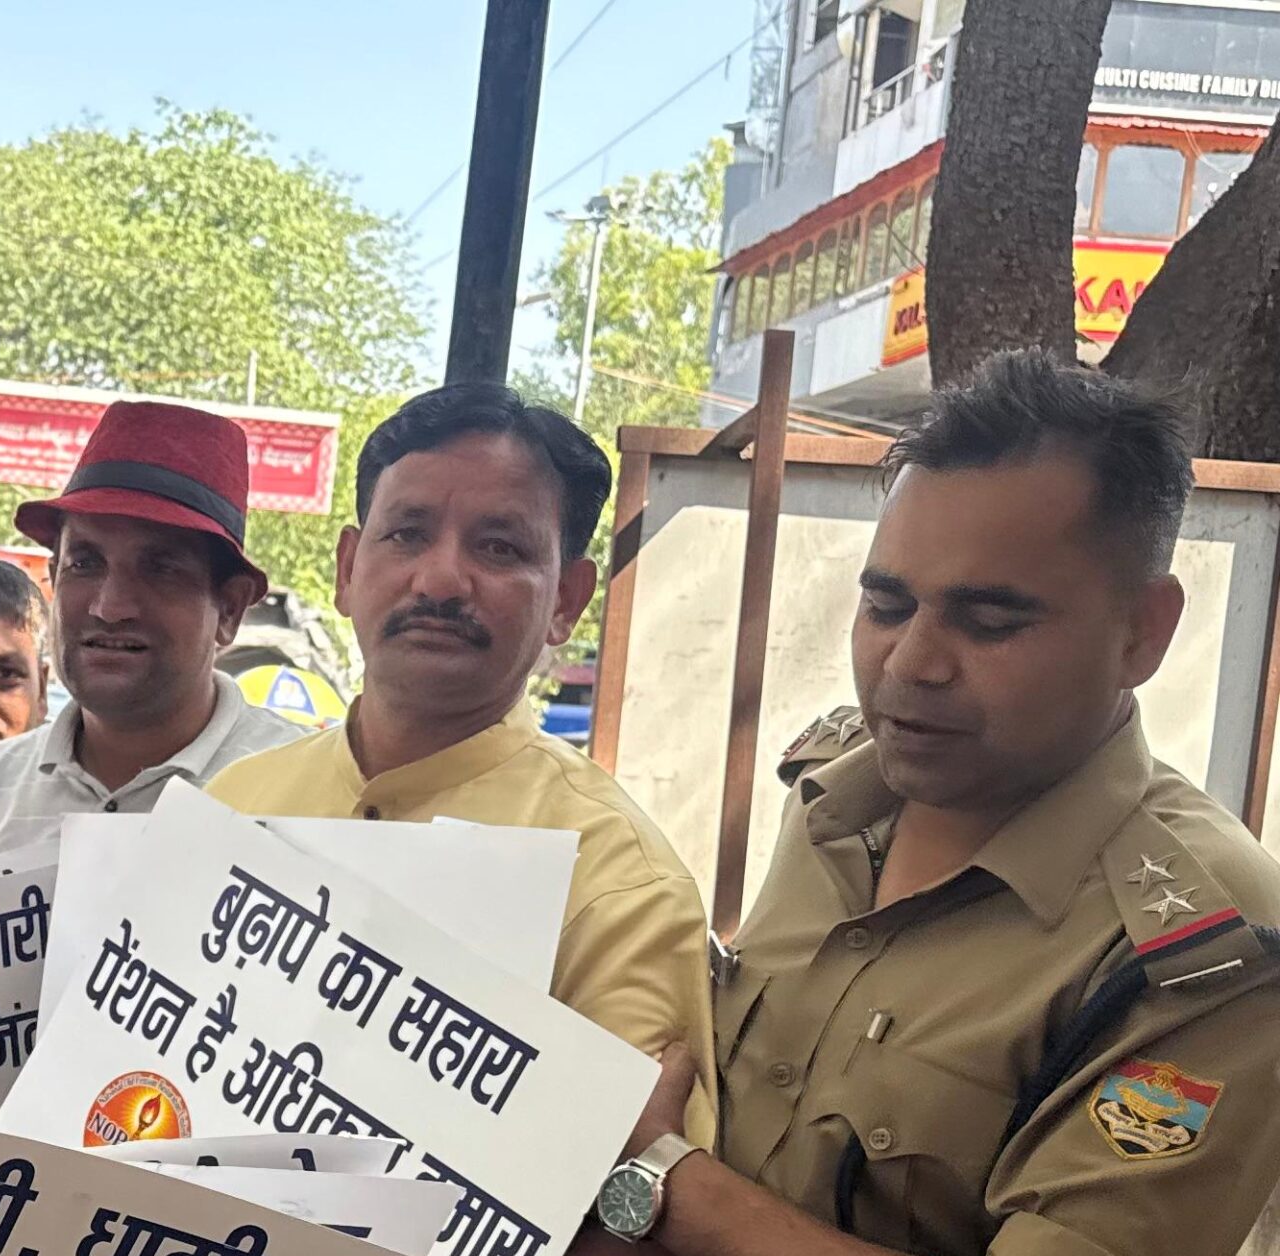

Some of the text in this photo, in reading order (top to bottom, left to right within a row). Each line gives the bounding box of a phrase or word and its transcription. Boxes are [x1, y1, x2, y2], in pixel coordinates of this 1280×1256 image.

[1139, 69, 1200, 93] CUISINE
[1202, 74, 1258, 97] FAMILY
[85, 918, 197, 1057] पेंशन
[185, 984, 238, 1082] है
[317, 932, 403, 1029] का
[388, 976, 540, 1115] सहारा
